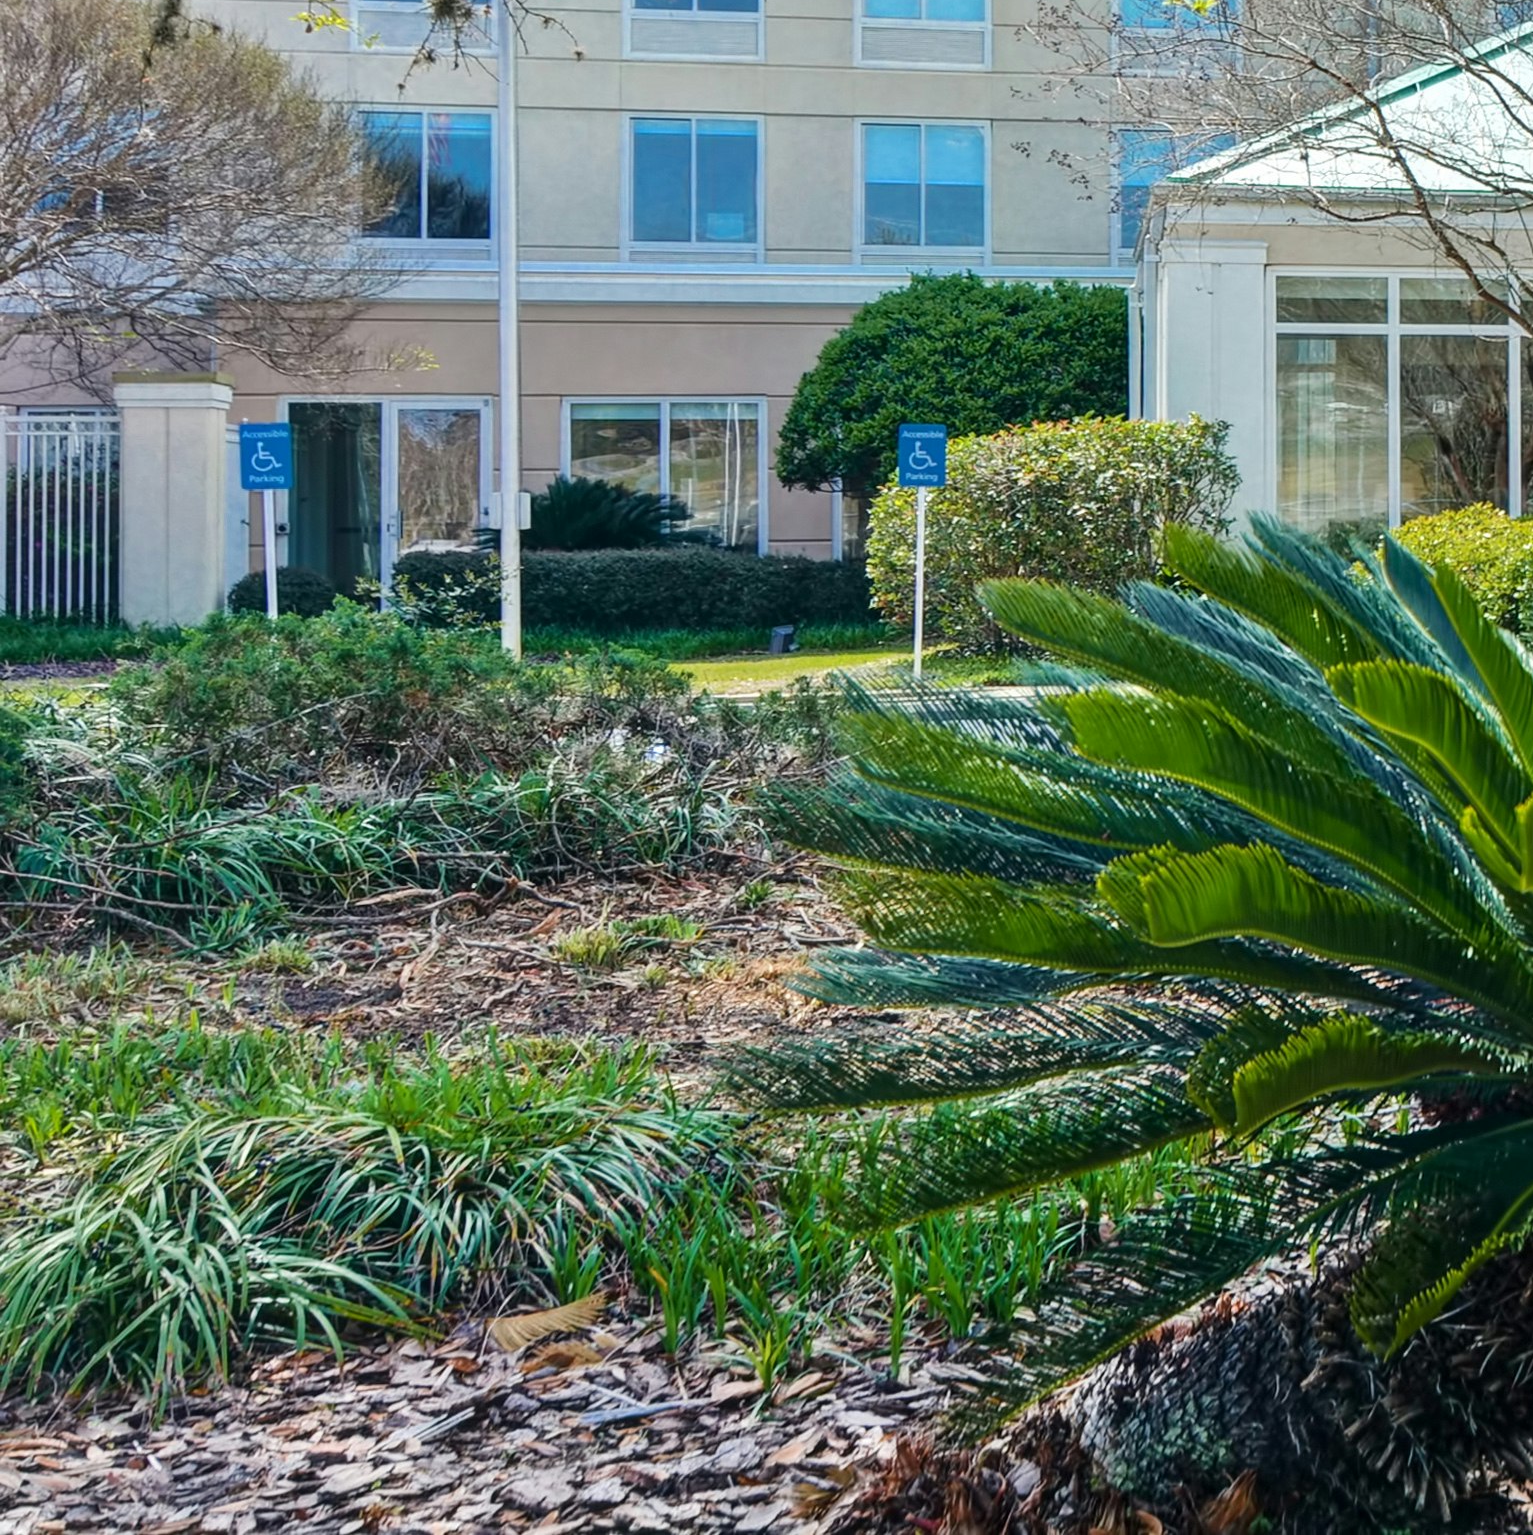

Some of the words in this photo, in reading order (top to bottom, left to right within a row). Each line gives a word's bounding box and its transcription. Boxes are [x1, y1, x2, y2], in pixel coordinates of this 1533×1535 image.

[242, 429, 289, 439] Accessible
[901, 430, 944, 439] Accessible
[249, 474, 285, 484] Parking
[905, 472, 939, 482] Parking
